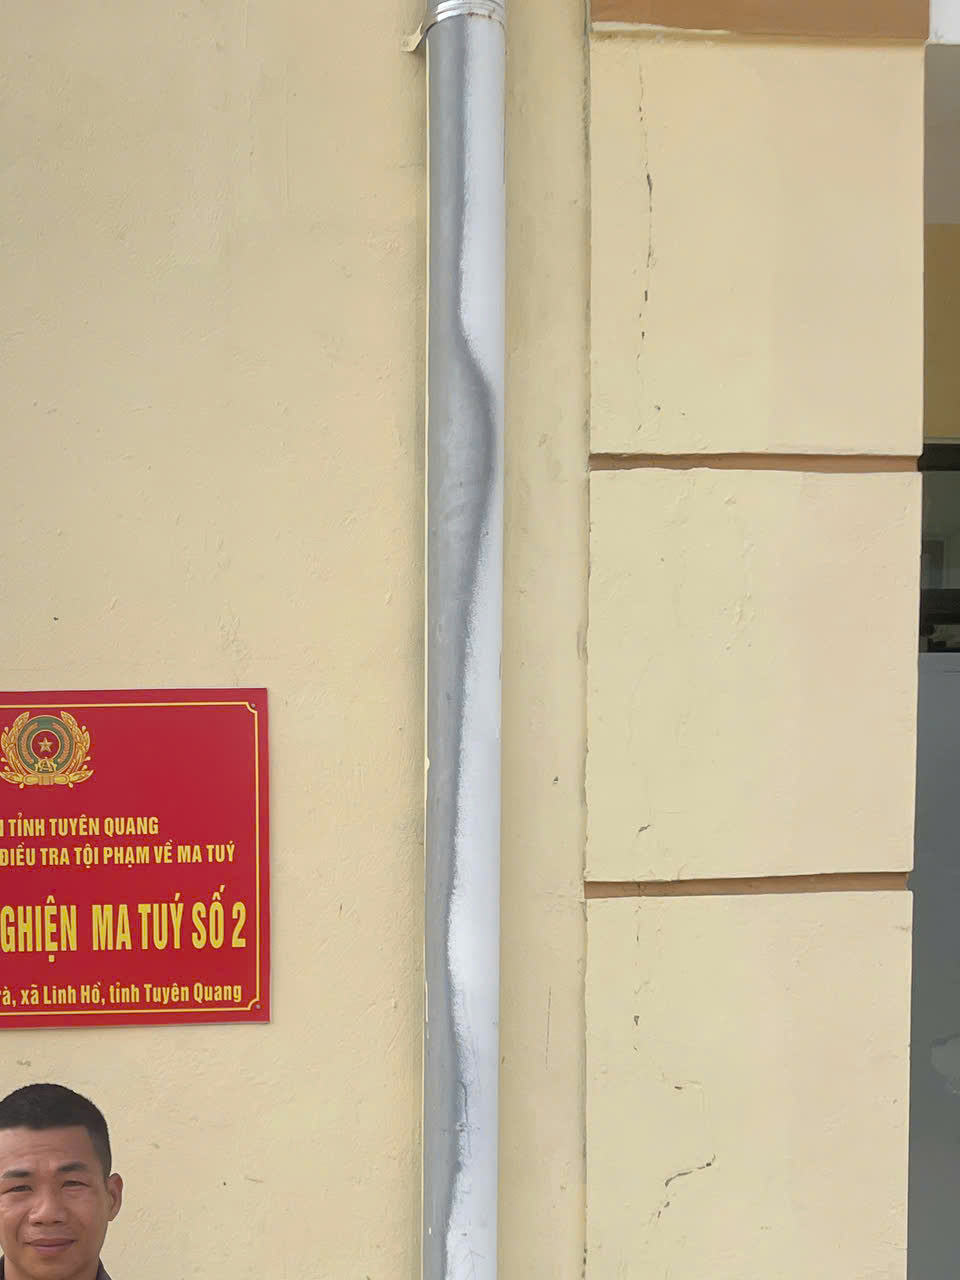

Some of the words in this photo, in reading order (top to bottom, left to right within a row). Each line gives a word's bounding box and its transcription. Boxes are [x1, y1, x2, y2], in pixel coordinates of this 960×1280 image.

[8, 812, 45, 837] TỈNH
[49, 814, 100, 837] TUYÊN
[104, 817, 159, 837] QUANG
[0, 840, 36, 867] ĐIỀU
[40, 848, 70, 866] TRA
[74, 844, 99, 870] TỘI
[103, 846, 150, 869] PHẠM
[153, 839, 173, 864] VỀ
[177, 845, 203, 864] MA
[206, 841, 235, 863] TUÝ
[92, 904, 133, 951] MA
[138, 892, 185, 950] TUÝ
[191, 884, 224, 949] SỐ
[232, 901, 247, 948] 2
[20, 984, 39, 1005] xã
[44, 985, 77, 1005] Linh
[81, 981, 106, 1006] Hồ,
[110, 982, 139, 1004] tỉnh
[144, 983, 189, 1005] Tuyên
[193, 982, 242, 1004] Quang
